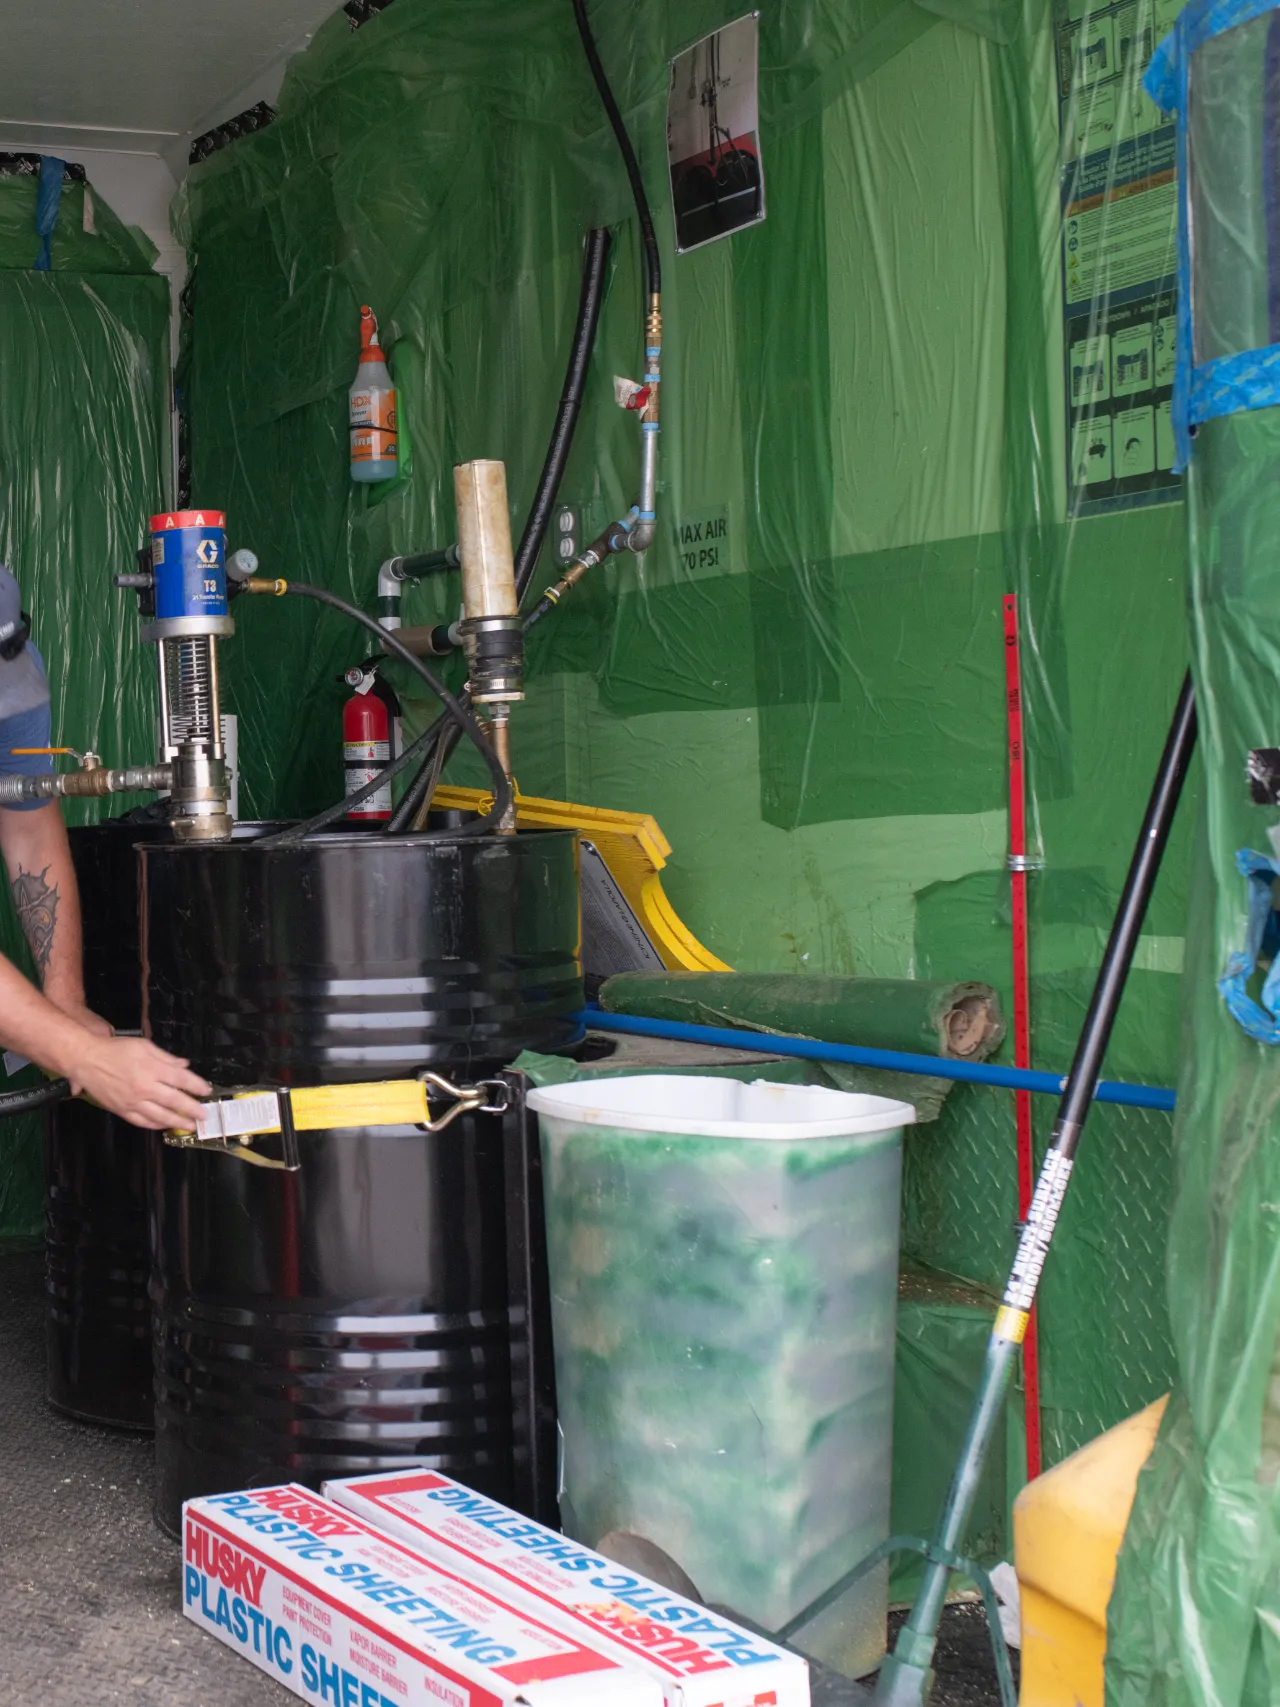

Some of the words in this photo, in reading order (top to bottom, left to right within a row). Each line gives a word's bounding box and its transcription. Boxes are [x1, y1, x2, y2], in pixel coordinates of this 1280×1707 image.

[166, 516, 174, 528] A
[195, 514, 205, 526] A
[705, 519, 726, 540] AIR
[700, 547, 719, 568] PSI
[204, 580, 217, 592] T3
[247, 1489, 362, 1538] HUSKY
[426, 1488, 606, 1572] SHEETING
[186, 1520, 267, 1608] HUSKY
[206, 1494, 344, 1561] PLASTIC
[324, 1563, 517, 1664] SHEETING
[185, 1564, 293, 1674] PLASTIC
[282, 1585, 313, 1614] EQUIPMENT
[313, 1606, 333, 1629] COVER
[282, 1605, 299, 1623] PAINT
[299, 1613, 333, 1647] PROTECTION
[589, 1574, 782, 1667] PLASTIC
[349, 1628, 369, 1651] VAPOR
[370, 1641, 397, 1669] BARRIER
[349, 1648, 381, 1680] MOISTURE
[381, 1670, 408, 1697] BARRIER
